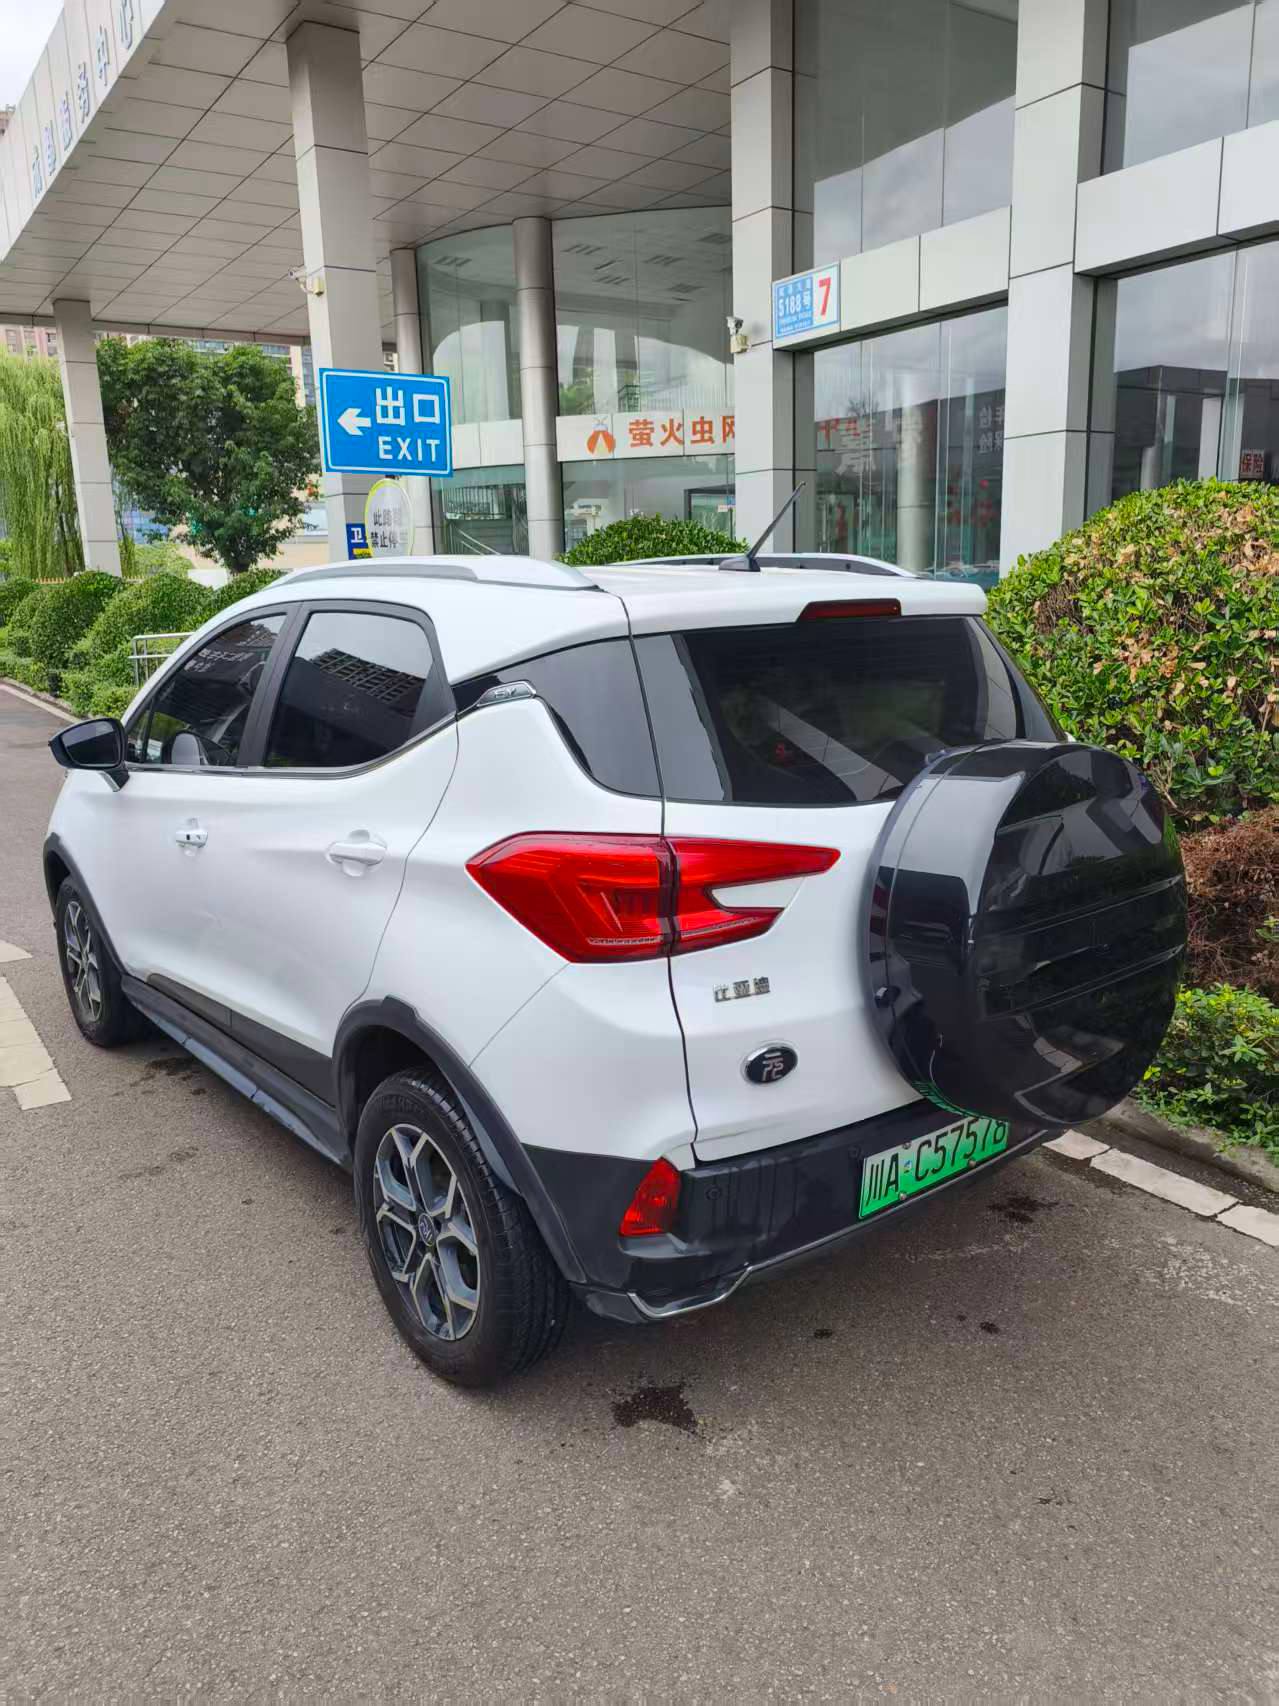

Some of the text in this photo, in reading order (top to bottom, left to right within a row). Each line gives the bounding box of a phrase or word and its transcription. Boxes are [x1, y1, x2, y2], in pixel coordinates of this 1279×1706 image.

[818, 277, 832, 317] 7
[375, 386, 441, 426] 出口
[378, 436, 441, 463] EXIT
